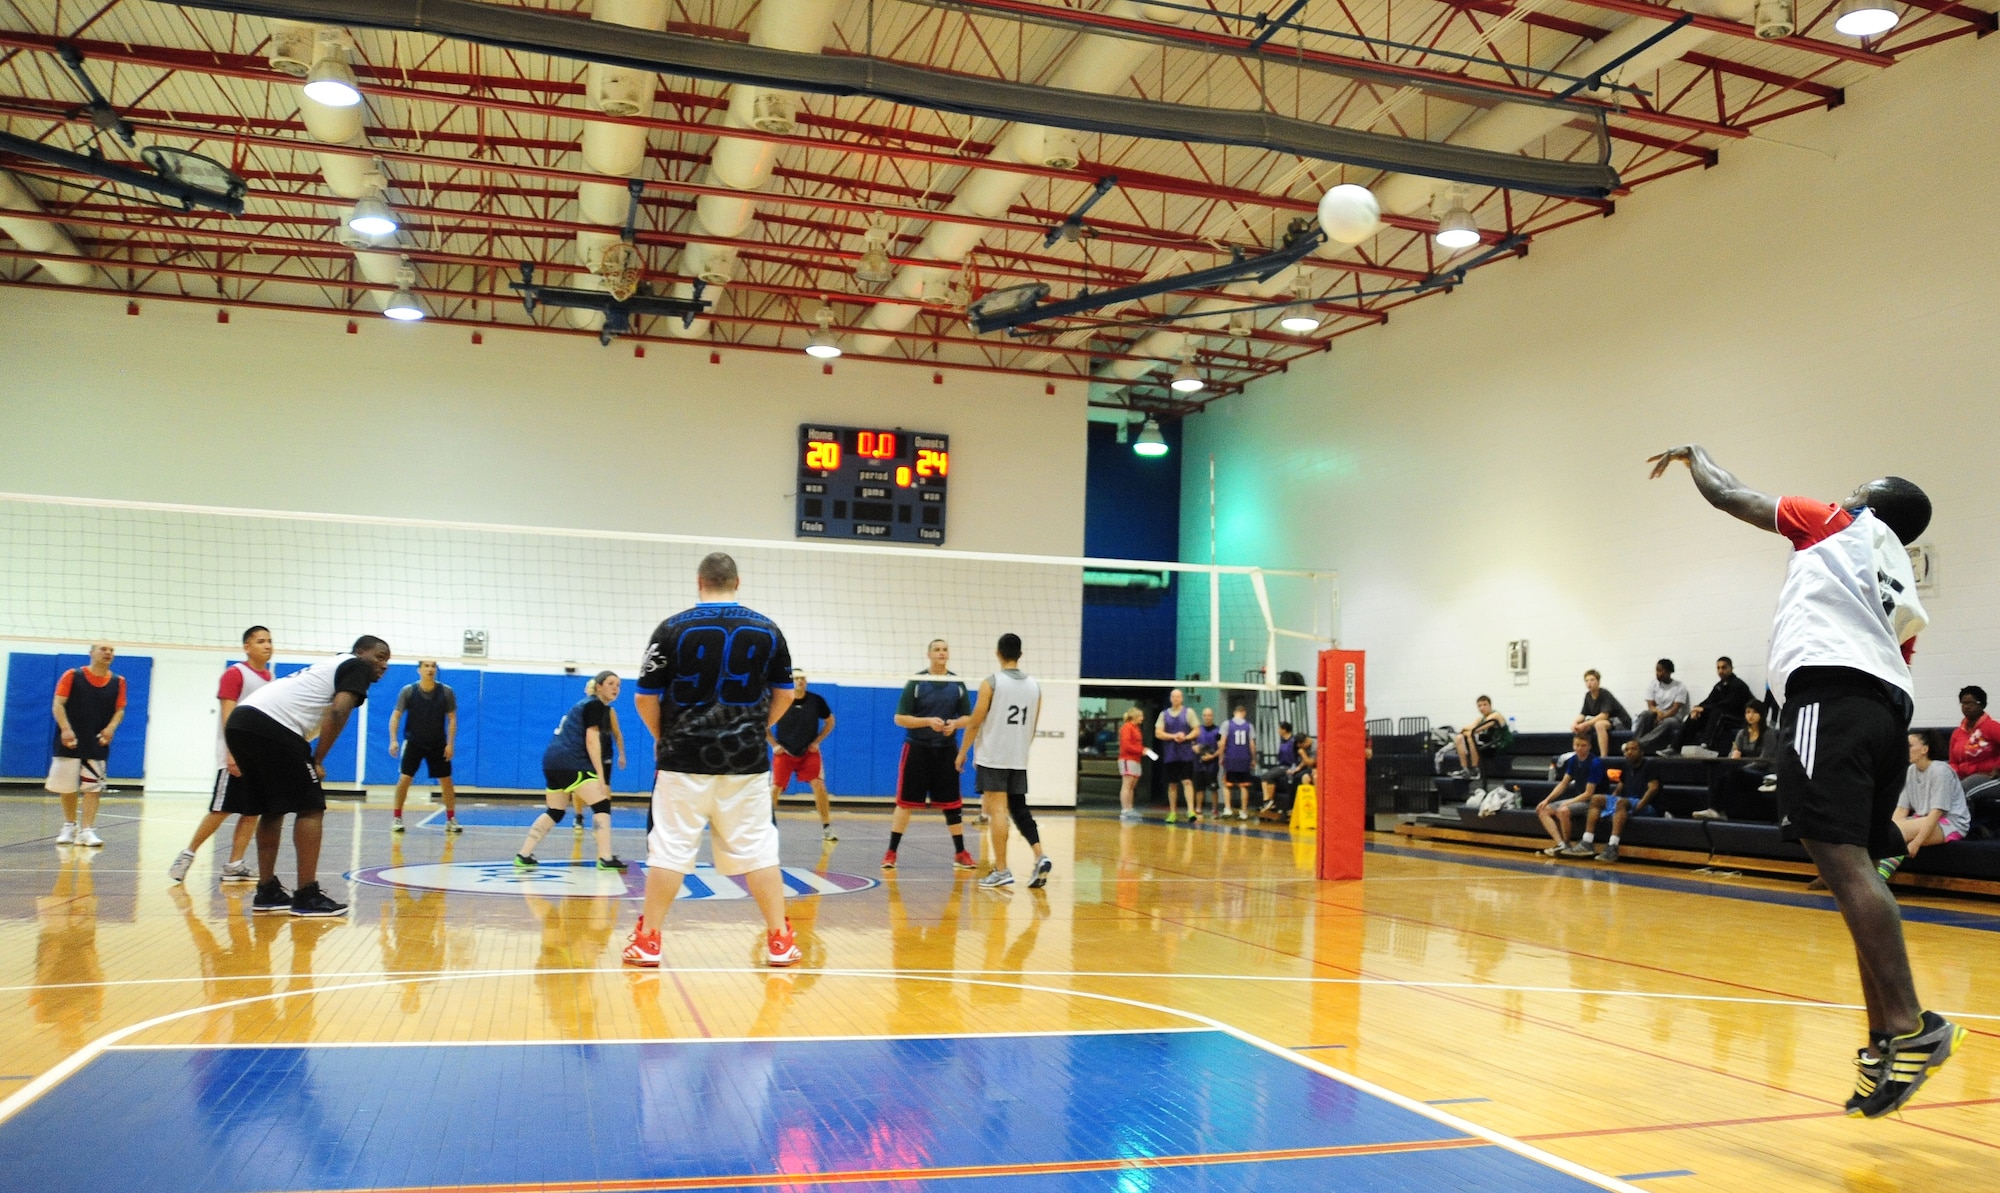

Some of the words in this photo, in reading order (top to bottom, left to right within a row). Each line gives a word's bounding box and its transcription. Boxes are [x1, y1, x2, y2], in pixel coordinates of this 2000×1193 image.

[857, 431, 895, 458] 0.0
[806, 441, 840, 471] 20
[916, 449, 949, 476] 24
[860, 471, 889, 480] period
[895, 466, 912, 487] 0
[862, 488, 885, 497] game
[856, 524, 886, 536] player
[671, 625, 777, 707] 99
[1007, 704, 1028, 726] 21
[1234, 729, 1247, 746] 11
